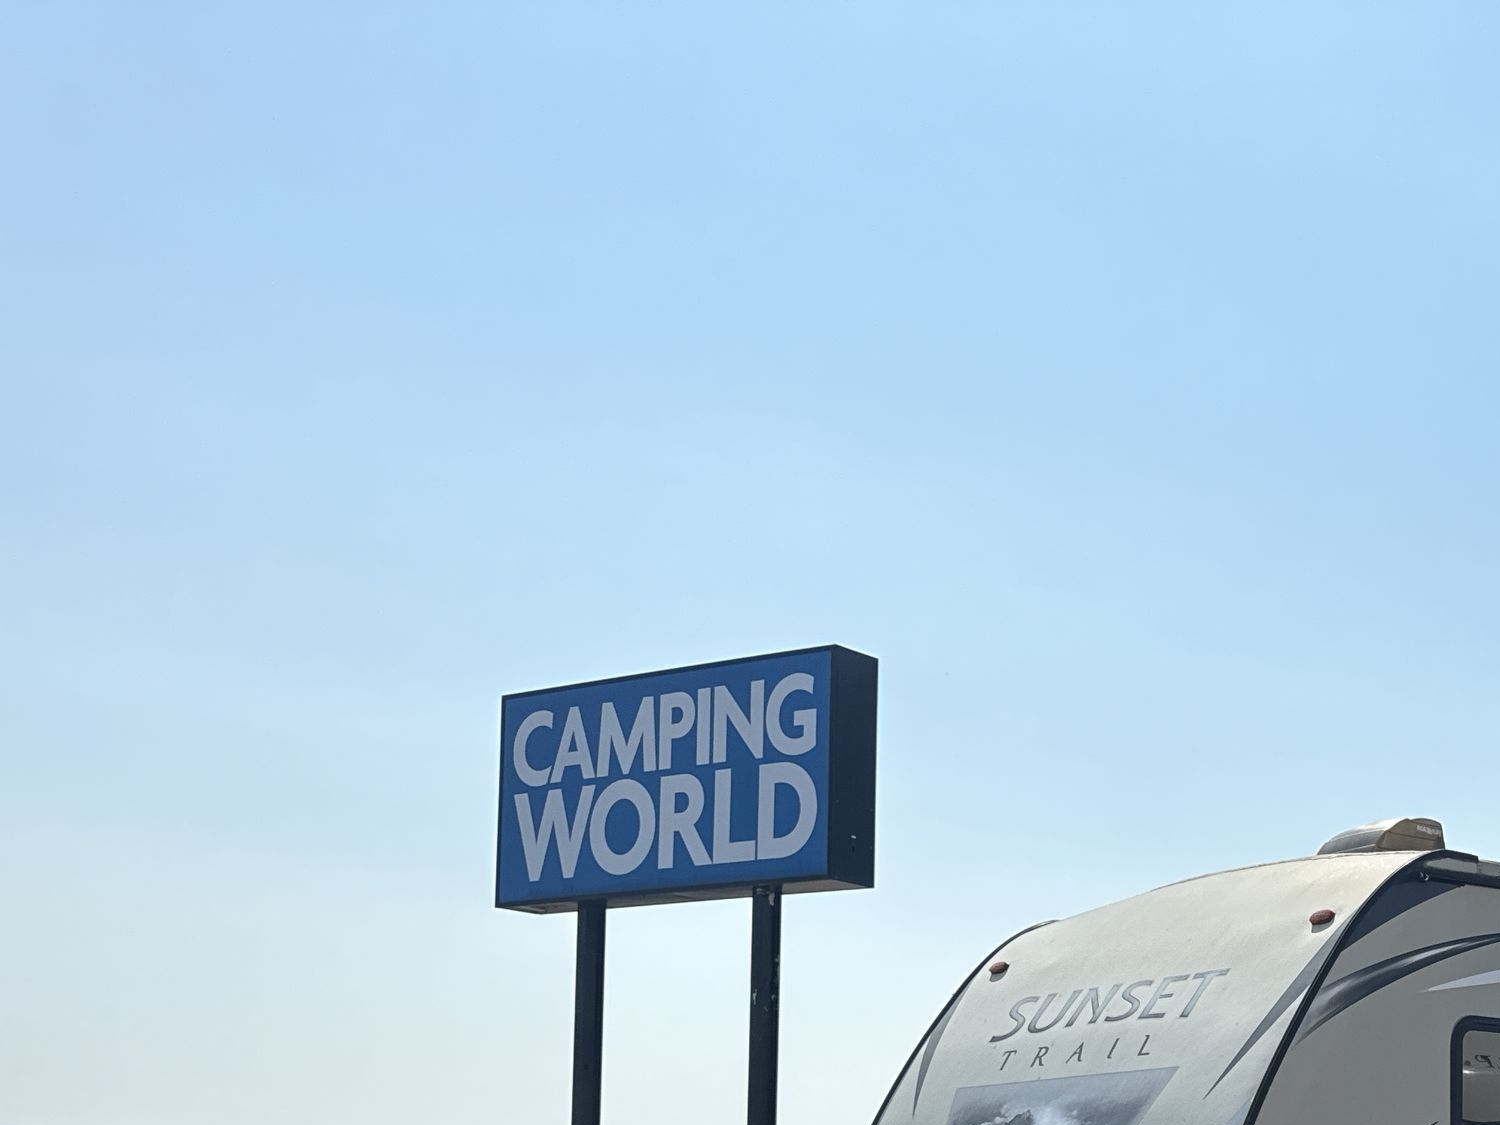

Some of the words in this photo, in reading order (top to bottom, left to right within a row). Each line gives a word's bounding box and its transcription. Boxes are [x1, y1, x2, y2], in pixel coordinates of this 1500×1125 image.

[513, 672, 818, 787] CAMPING
[513, 762, 818, 882] WORLD
[989, 968, 1231, 1042] SUNSET
[1000, 1034, 1151, 1071] TRAIL
